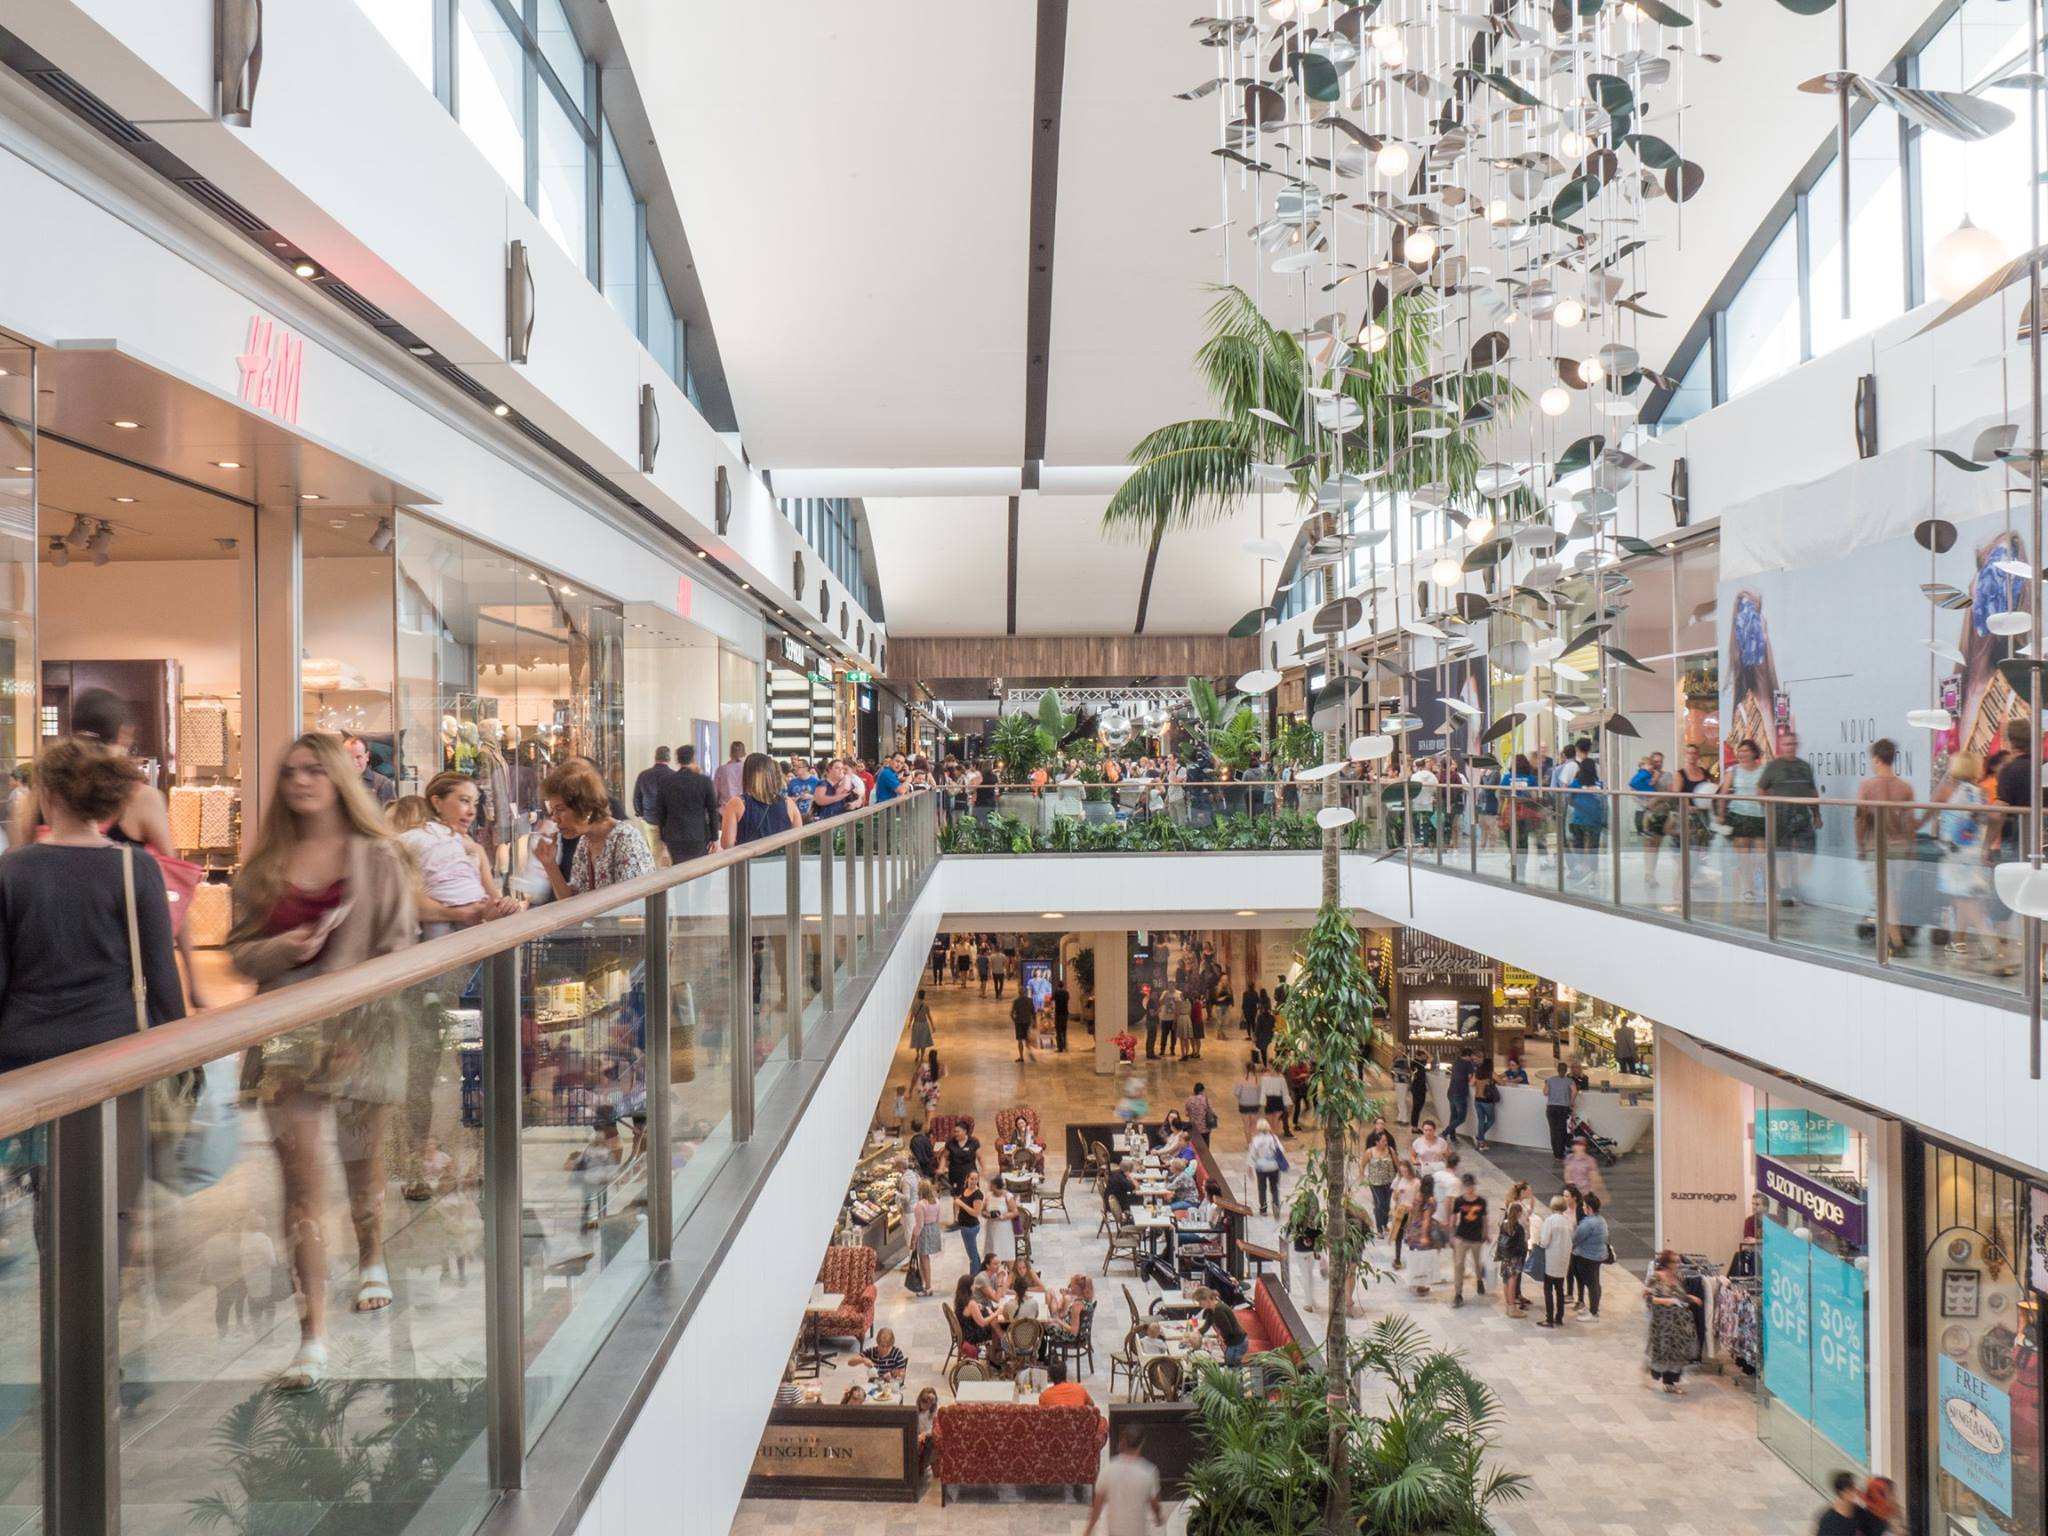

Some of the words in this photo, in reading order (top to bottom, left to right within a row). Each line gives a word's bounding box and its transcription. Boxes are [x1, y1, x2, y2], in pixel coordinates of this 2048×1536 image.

[235, 315, 303, 425] H&M
[1841, 718, 1875, 743] NOVO
[1809, 752, 1866, 776] OPENING
[1769, 1120, 1800, 1133] 30%
[1806, 1119, 1835, 1131] OFF
[1671, 1192, 1737, 1203] suzannegrae
[1766, 1170, 1845, 1225] suzannegrae
[1771, 1268, 1807, 1315] 30%
[1771, 1300, 1807, 1344] OFF
[1820, 1301, 1861, 1350] 30%
[1821, 1335, 1861, 1381] OFF
[1956, 1366, 1989, 1401] FREE
[762, 1446, 818, 1458] UNGLE
[823, 1447, 853, 1459] INN
